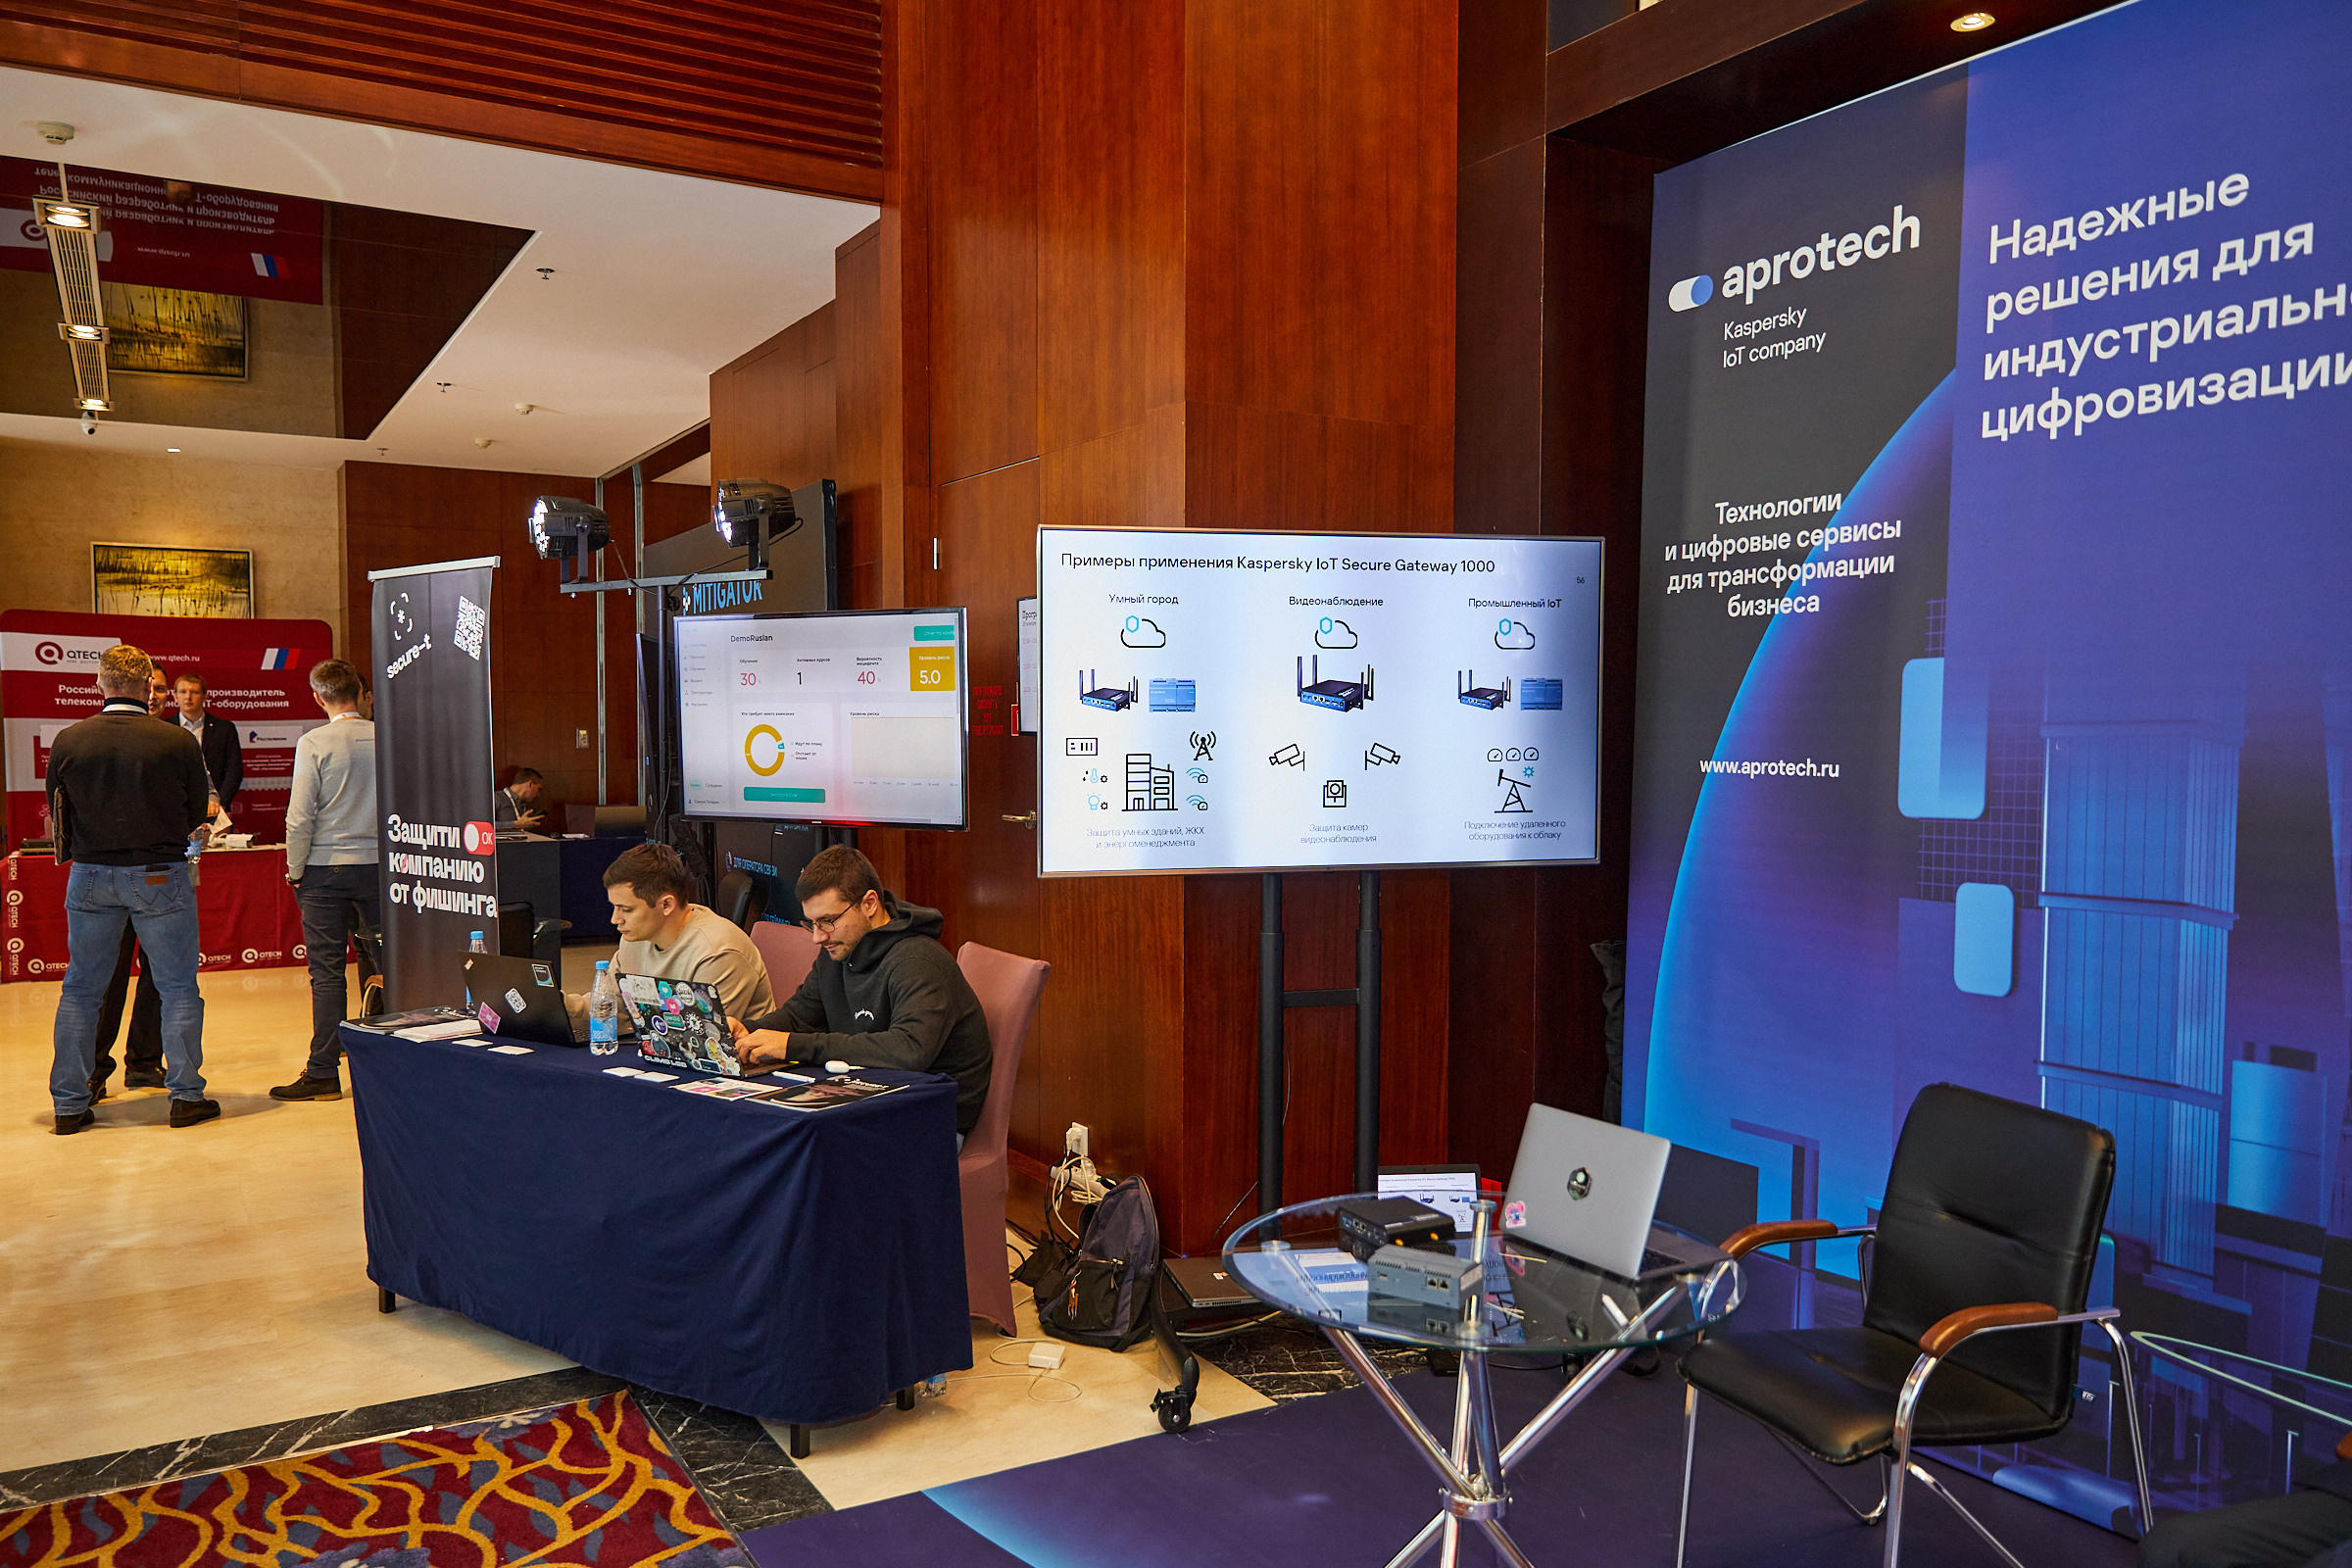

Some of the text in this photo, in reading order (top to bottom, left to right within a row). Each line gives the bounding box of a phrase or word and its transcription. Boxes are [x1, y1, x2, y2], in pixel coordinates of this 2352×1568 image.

[1989, 172, 2249, 265] Надежные
[1722, 204, 1921, 305] aprotech
[1986, 221, 2314, 334] решения для
[1724, 306, 1807, 341] Kaspersky
[1984, 282, 2352, 381] индустриальн
[1723, 332, 1827, 368] IoT company
[1715, 493, 1842, 524] Технологии
[1664, 519, 1901, 563] и цифровые сервисы
[1061, 553, 1495, 574] Примеры применения Kaspersky IoT Secure Gateway 1000
[1576, 576, 1586, 585] 56
[1667, 555, 1895, 595] для трансформации
[1108, 593, 1179, 606] Умный город
[1289, 596, 1384, 608] Видеонаблюдение
[1468, 598, 1563, 609] Промышленный IoT
[1727, 594, 1820, 618] бизнеса
[730, 634, 773, 643] DemoRuslan
[387, 633, 432, 679] secure-t
[740, 672, 757, 686] 30
[797, 671, 802, 685] 1
[858, 671, 875, 685] 40
[919, 669, 941, 684] 5.0
[1699, 758, 1839, 780] www.aprotech.ru
[387, 813, 461, 851] Защити
[1086, 828, 1120, 838] Защита
[1122, 829, 1150, 838] умных
[1185, 826, 1204, 835] ЖКХ
[1309, 823, 1369, 833] Защита камер
[1464, 820, 1566, 830] Подключение удаленного
[1300, 835, 1377, 844] видеонаблюдения
[1468, 832, 1526, 842] оборудования
[1533, 830, 1561, 840] облаку
[389, 852, 485, 884] компанию
[389, 880, 498, 918] от фишинга
